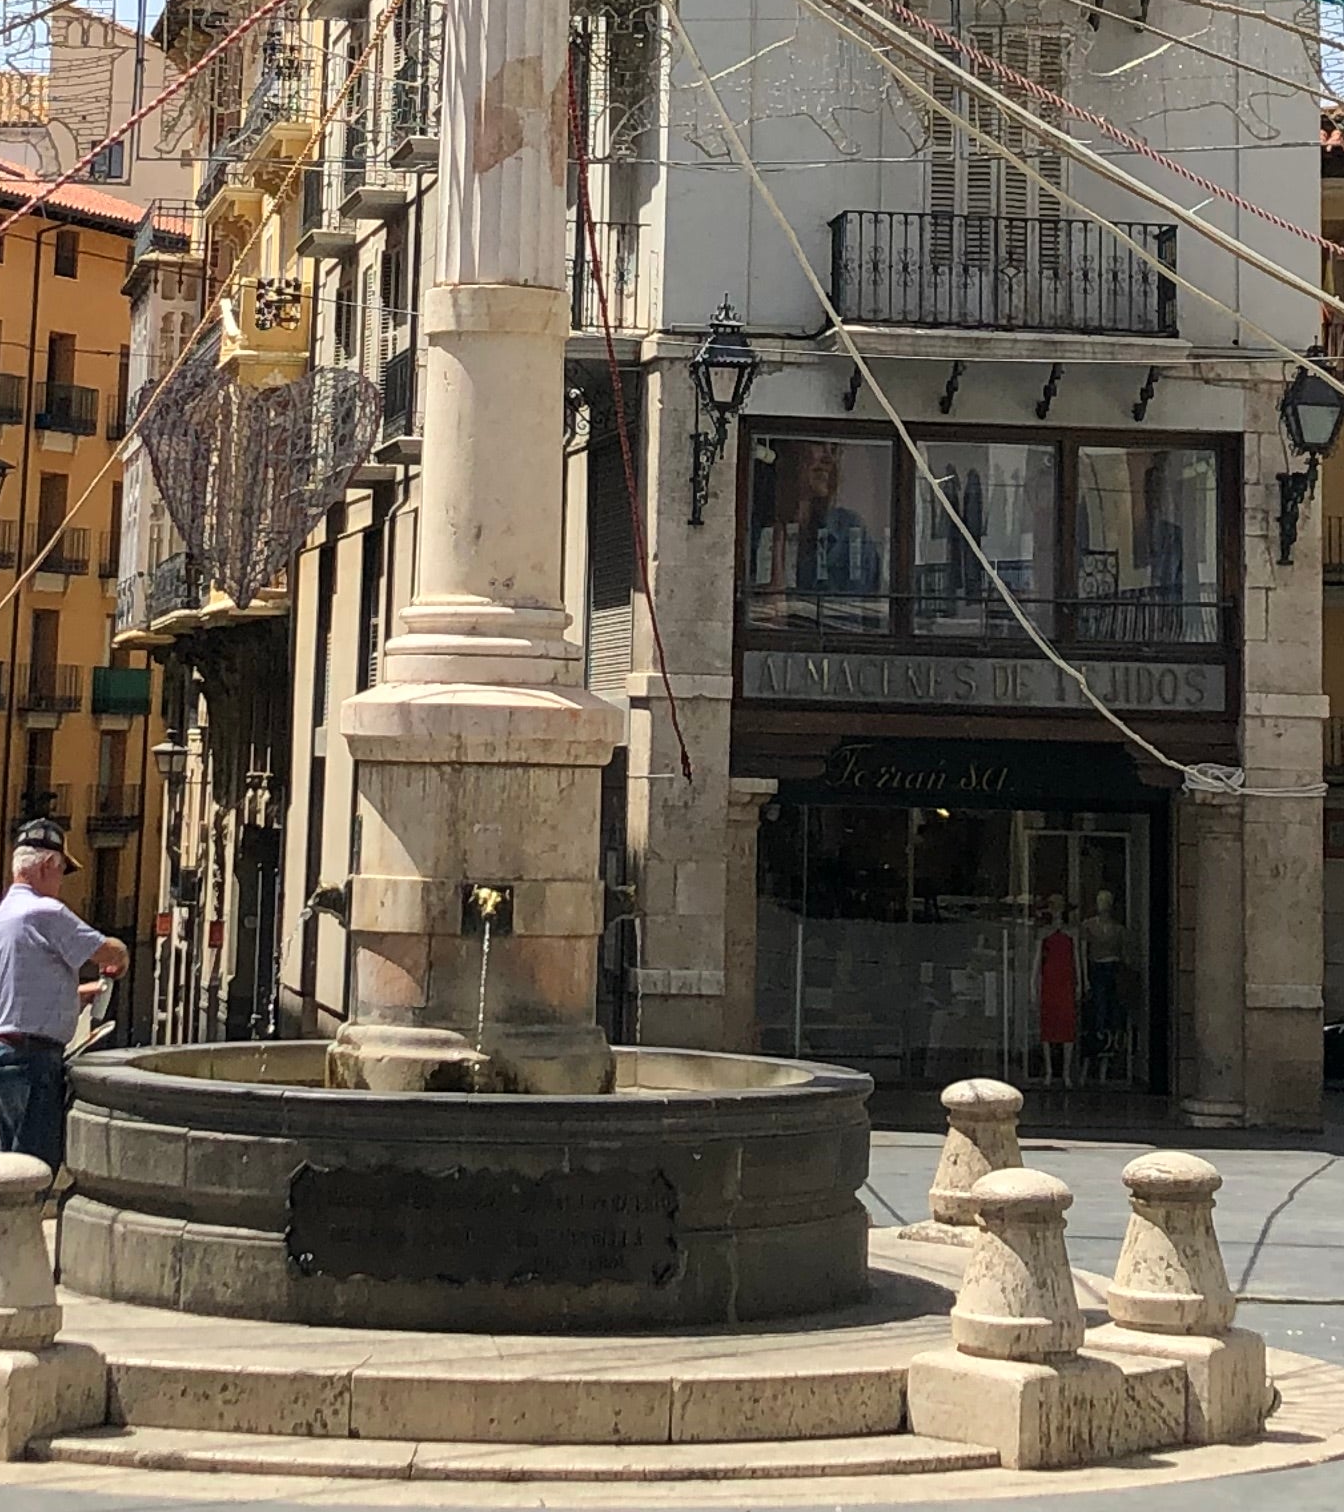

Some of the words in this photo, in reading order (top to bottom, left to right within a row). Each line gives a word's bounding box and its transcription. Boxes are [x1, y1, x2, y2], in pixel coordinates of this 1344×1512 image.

[759, 656, 977, 701] ALMACENES
[993, 662, 1033, 701] DE
[1044, 665, 1207, 706] TEJIDOS
